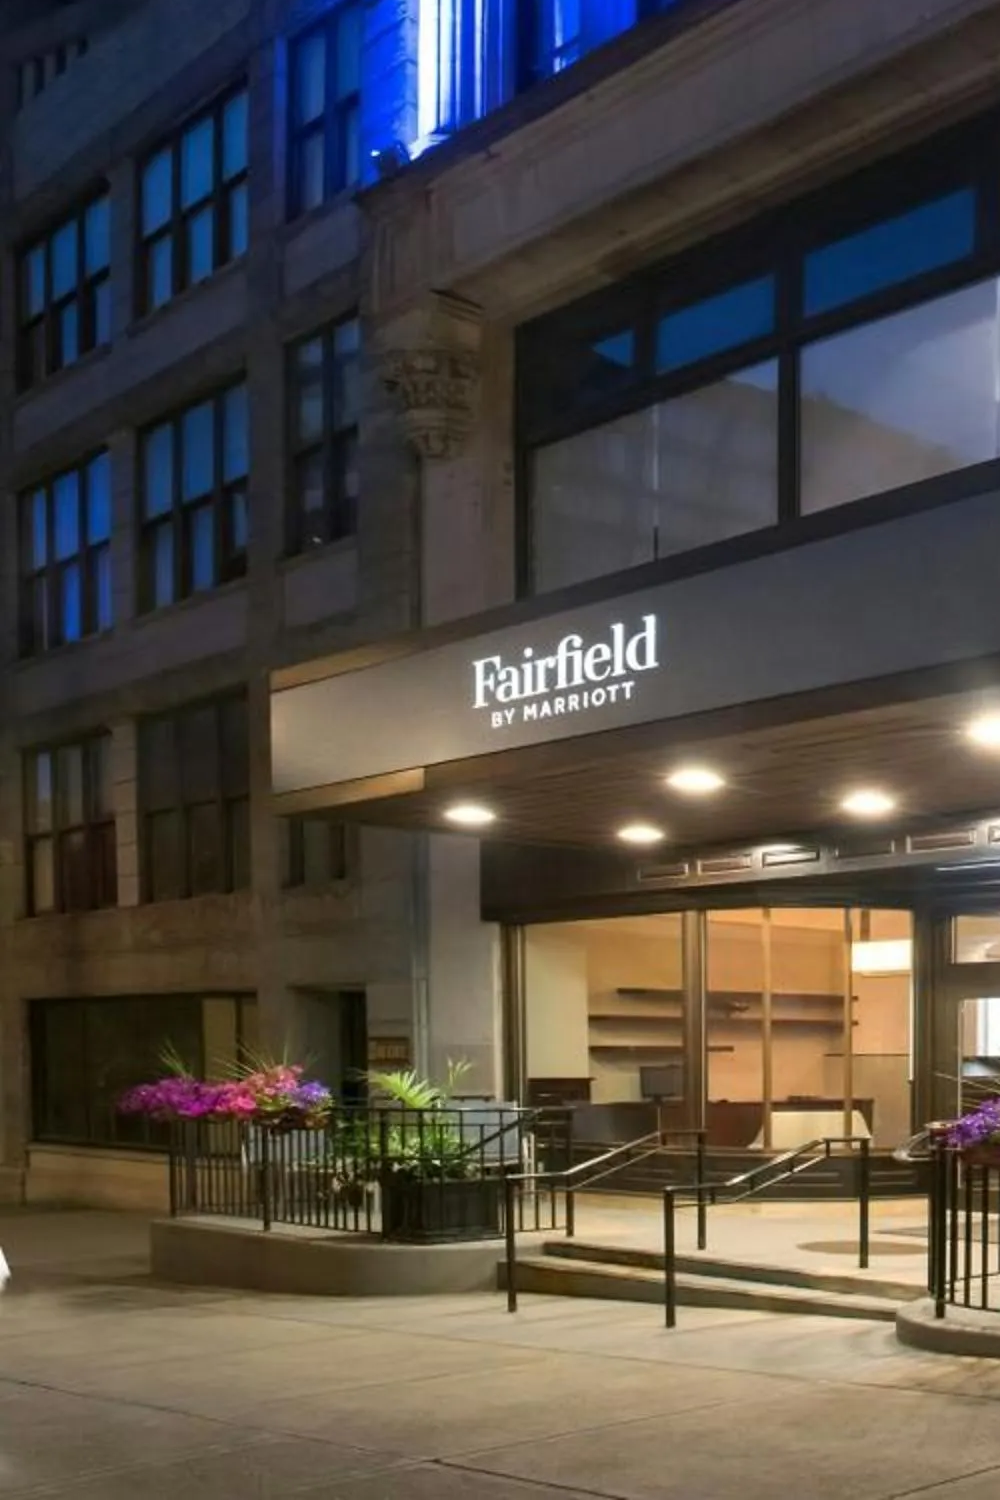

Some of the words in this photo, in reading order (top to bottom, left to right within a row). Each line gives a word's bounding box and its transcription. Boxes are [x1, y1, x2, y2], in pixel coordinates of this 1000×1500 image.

[471, 613, 659, 710] Fairfield
[490, 707, 516, 729] BY
[523, 680, 635, 722] MARRIOTT
